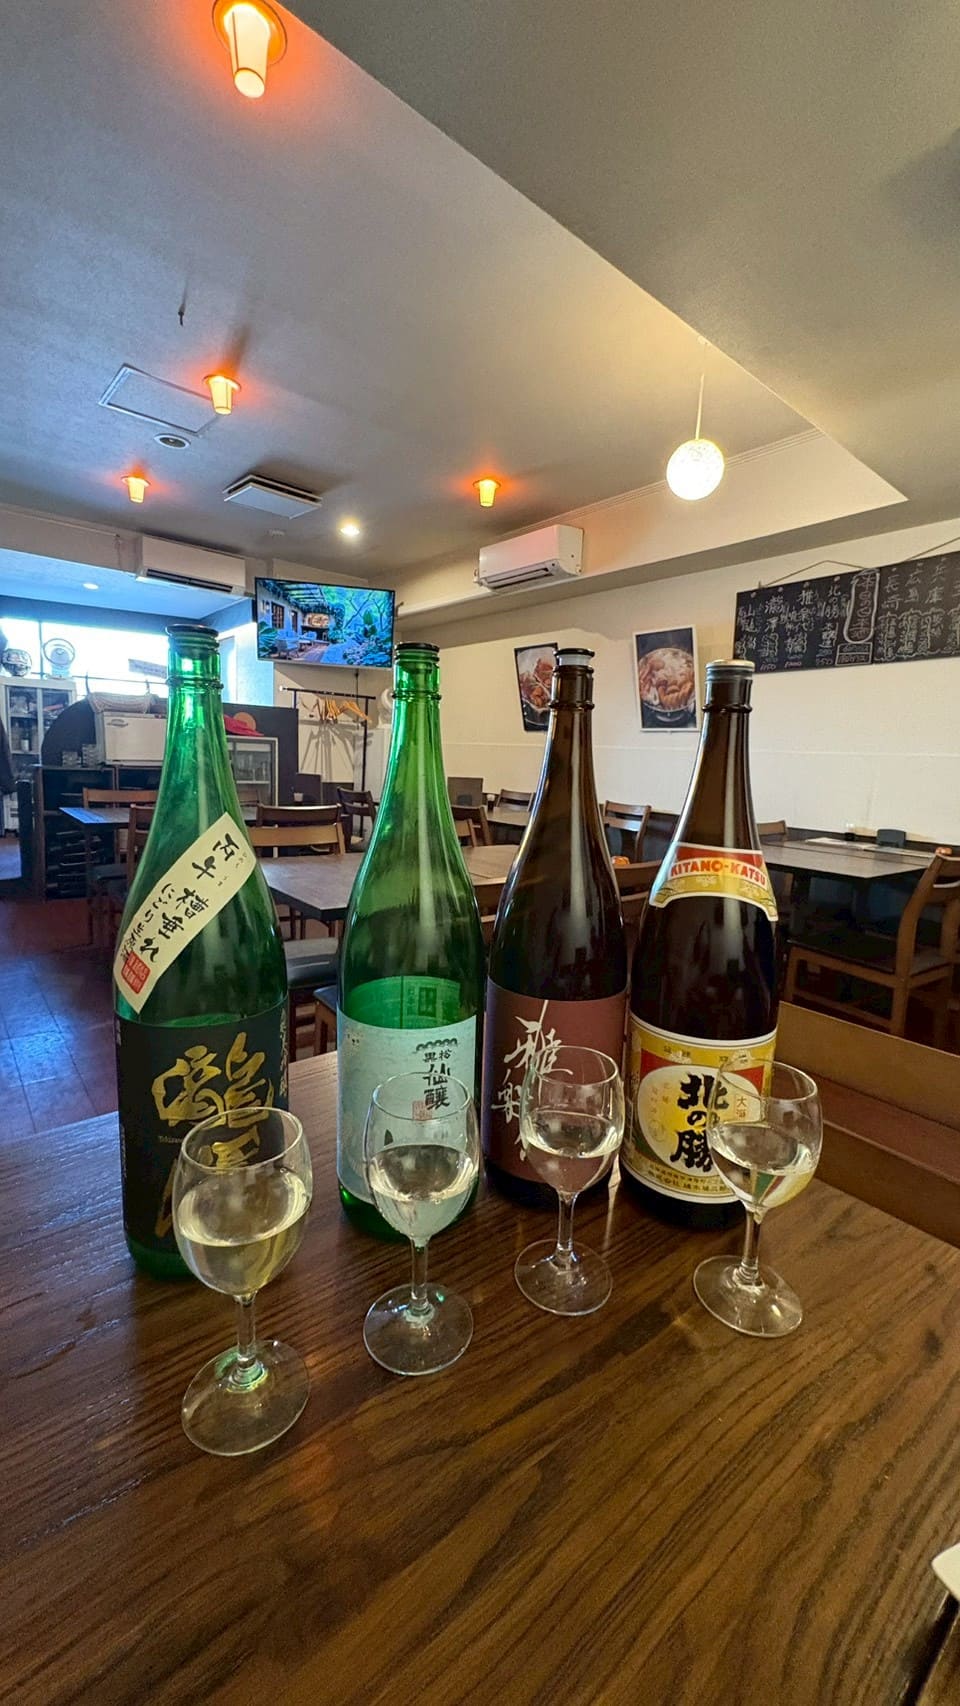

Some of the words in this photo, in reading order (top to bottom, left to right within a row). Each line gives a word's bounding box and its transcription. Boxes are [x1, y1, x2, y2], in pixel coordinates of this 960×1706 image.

[670, 859, 767, 887] KITANO-KATSU
[670, 1072, 730, 1172] 北の勝
